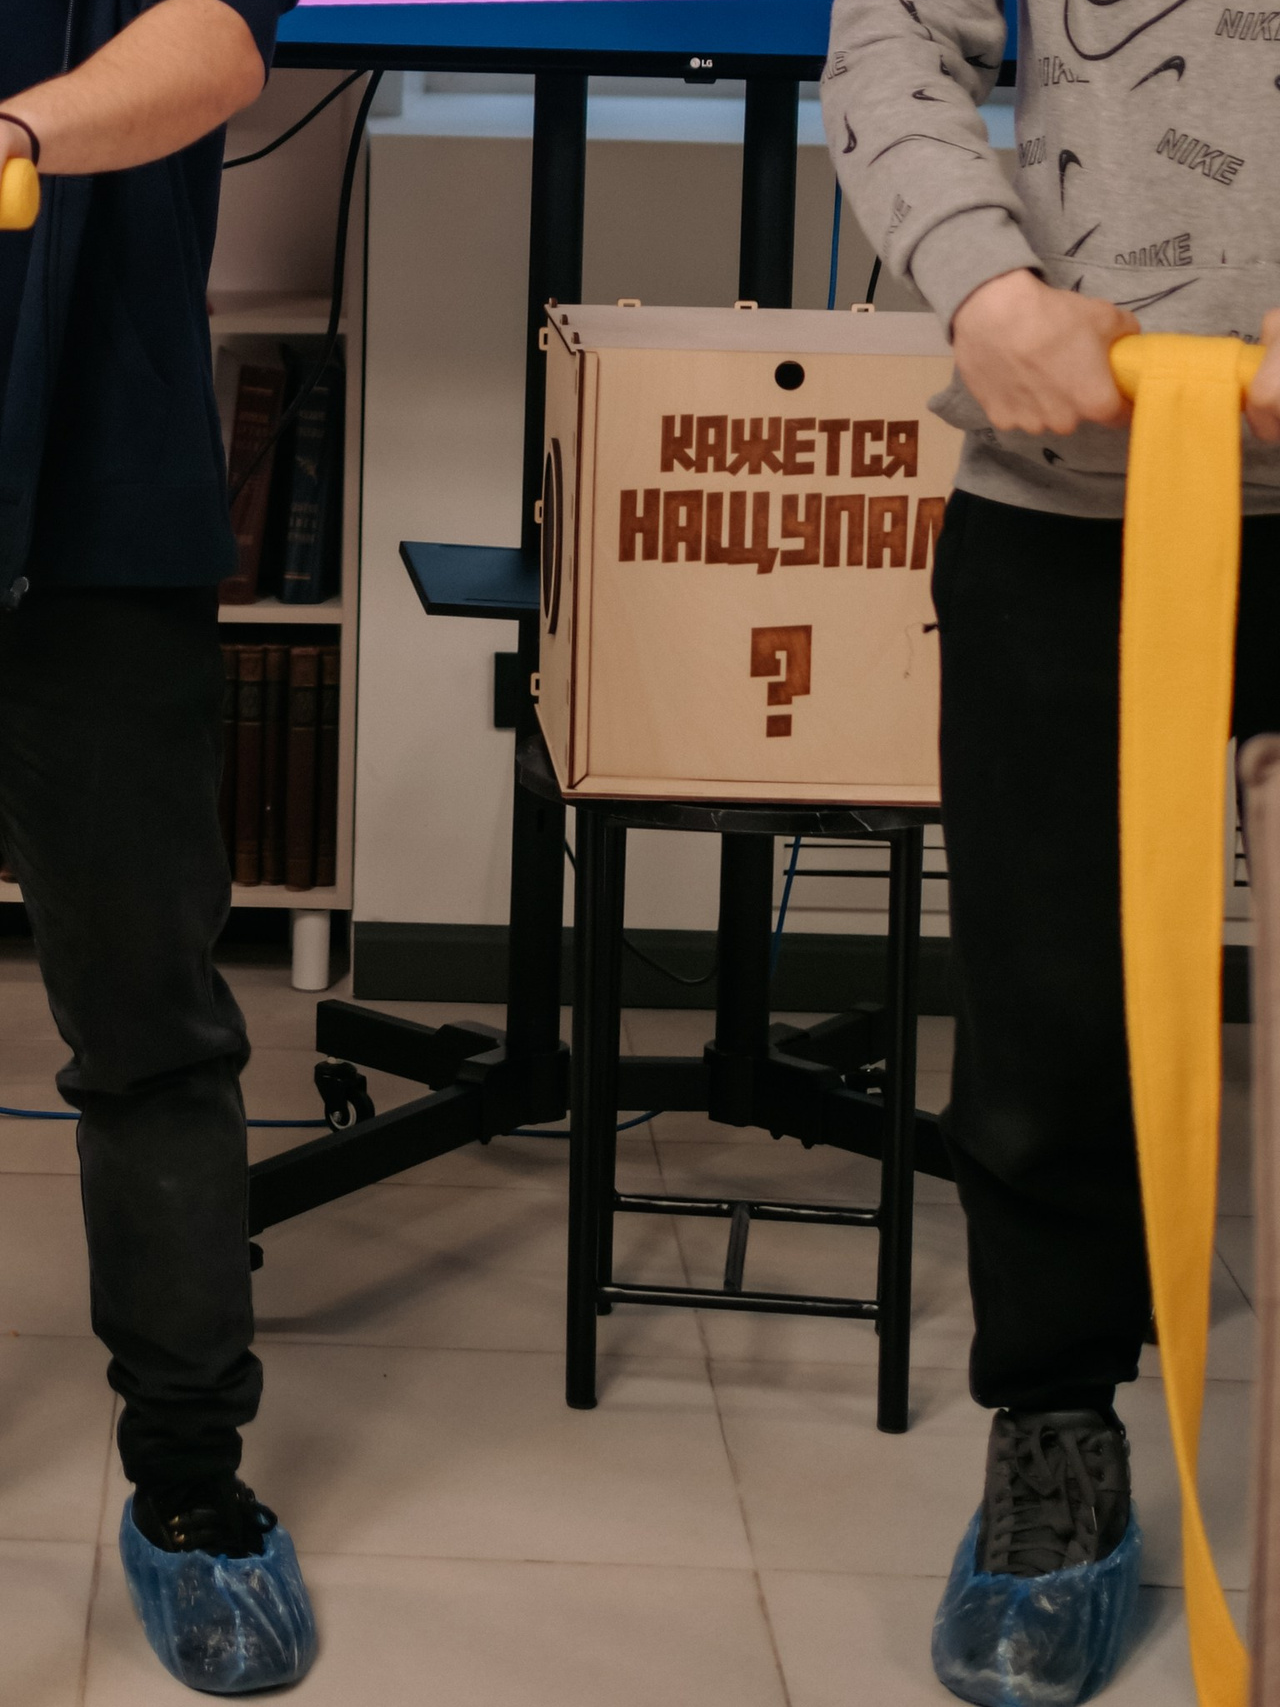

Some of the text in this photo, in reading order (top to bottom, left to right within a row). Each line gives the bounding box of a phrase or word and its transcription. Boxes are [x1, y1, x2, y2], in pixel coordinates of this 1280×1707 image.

[1215, 8, 1280, 41] NIK
[701, 58, 713, 68] LG
[1155, 126, 1246, 186] NIKE
[660, 413, 919, 479] КАЖЕТСЯ
[750, 624, 813, 738] ?
